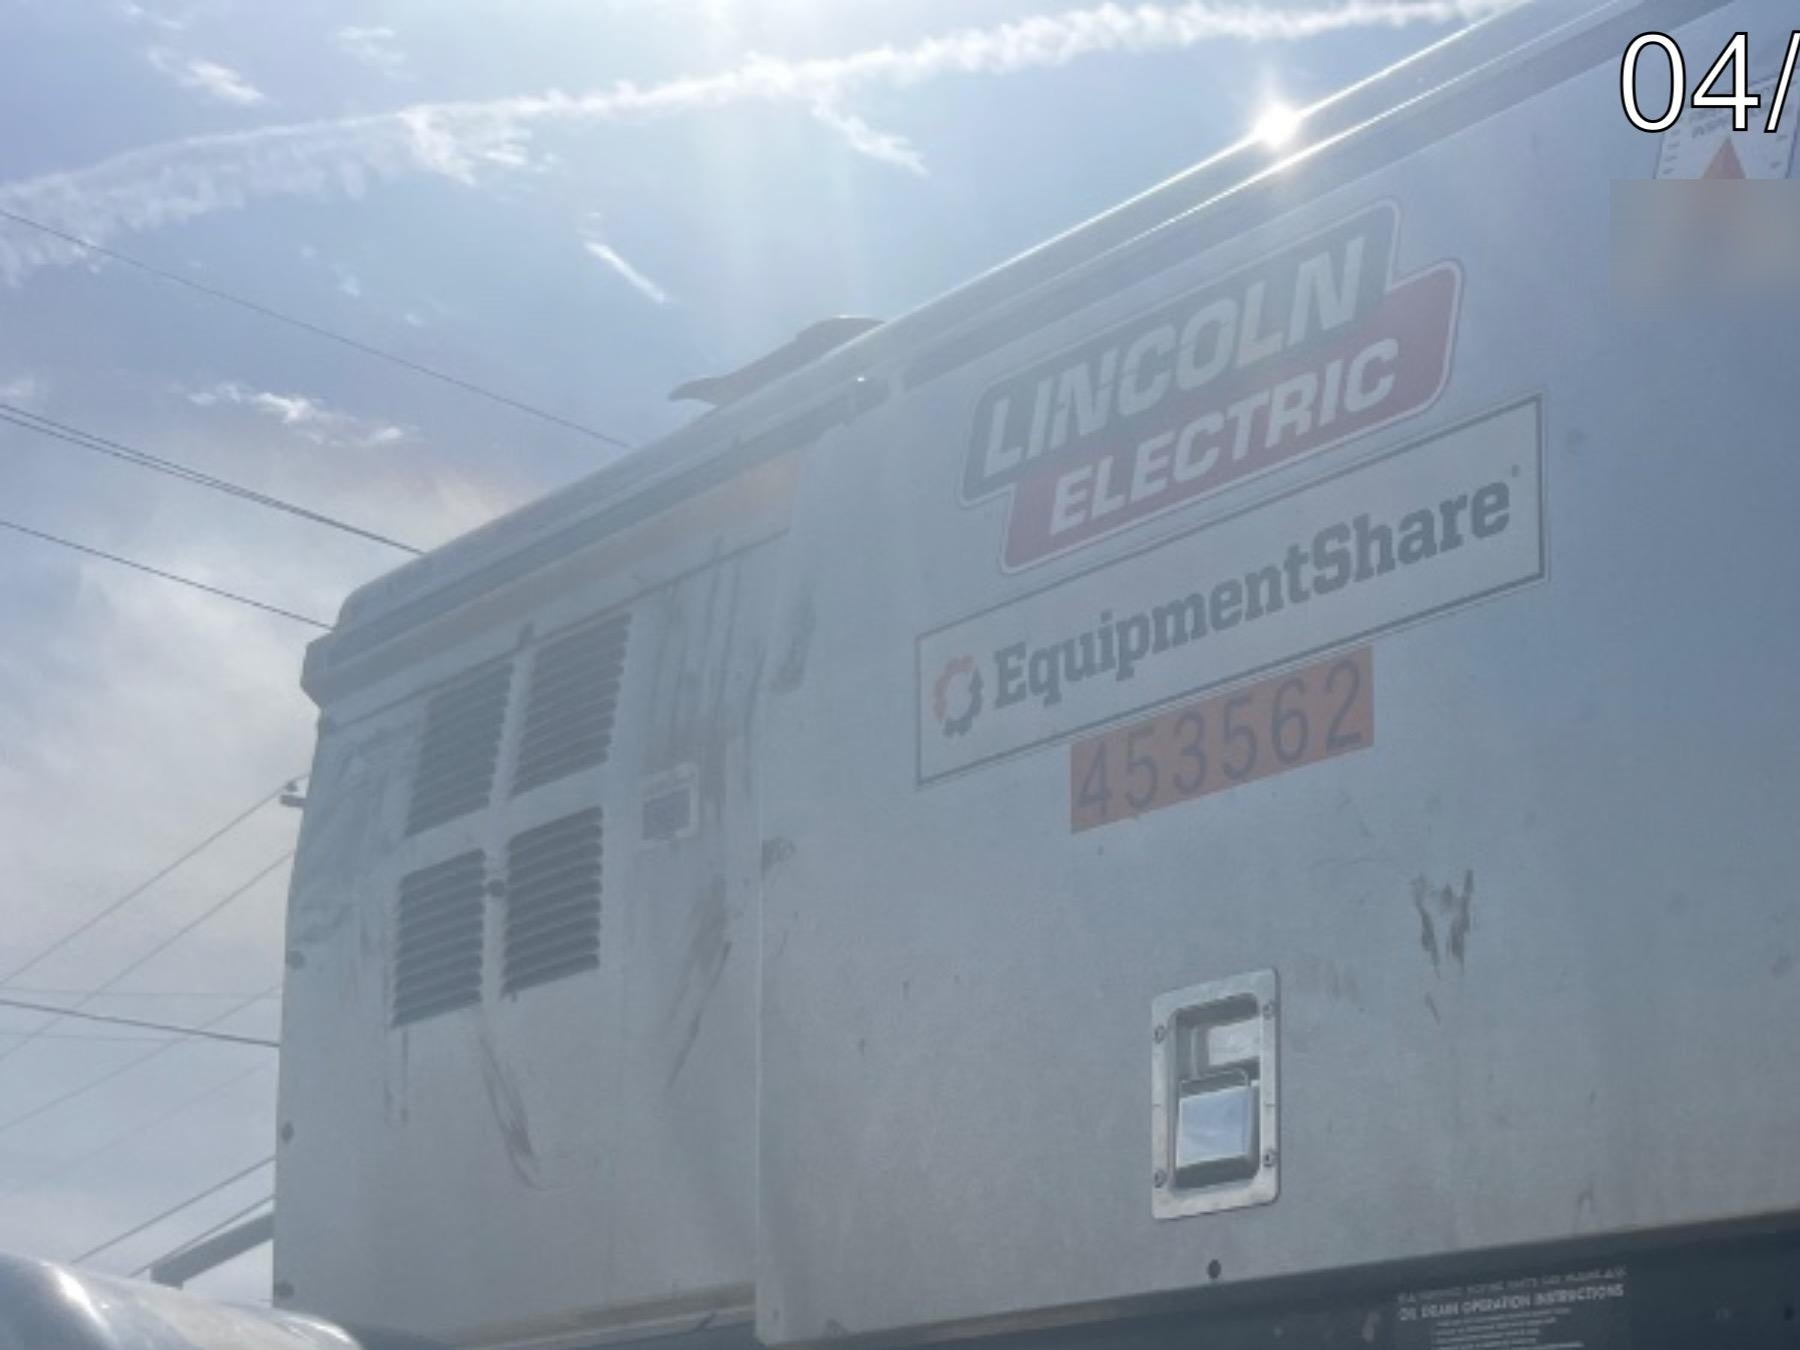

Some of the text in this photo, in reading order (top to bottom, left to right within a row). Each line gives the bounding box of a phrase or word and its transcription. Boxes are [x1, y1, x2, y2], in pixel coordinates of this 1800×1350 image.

[983, 235, 1366, 478] LINCOLN
[1049, 337, 1399, 536] ELECTRIC
[993, 481, 1513, 709] EquipmentShare
[1078, 658, 1364, 818] 453562
[1461, 1294, 1531, 1314] OPERATION
